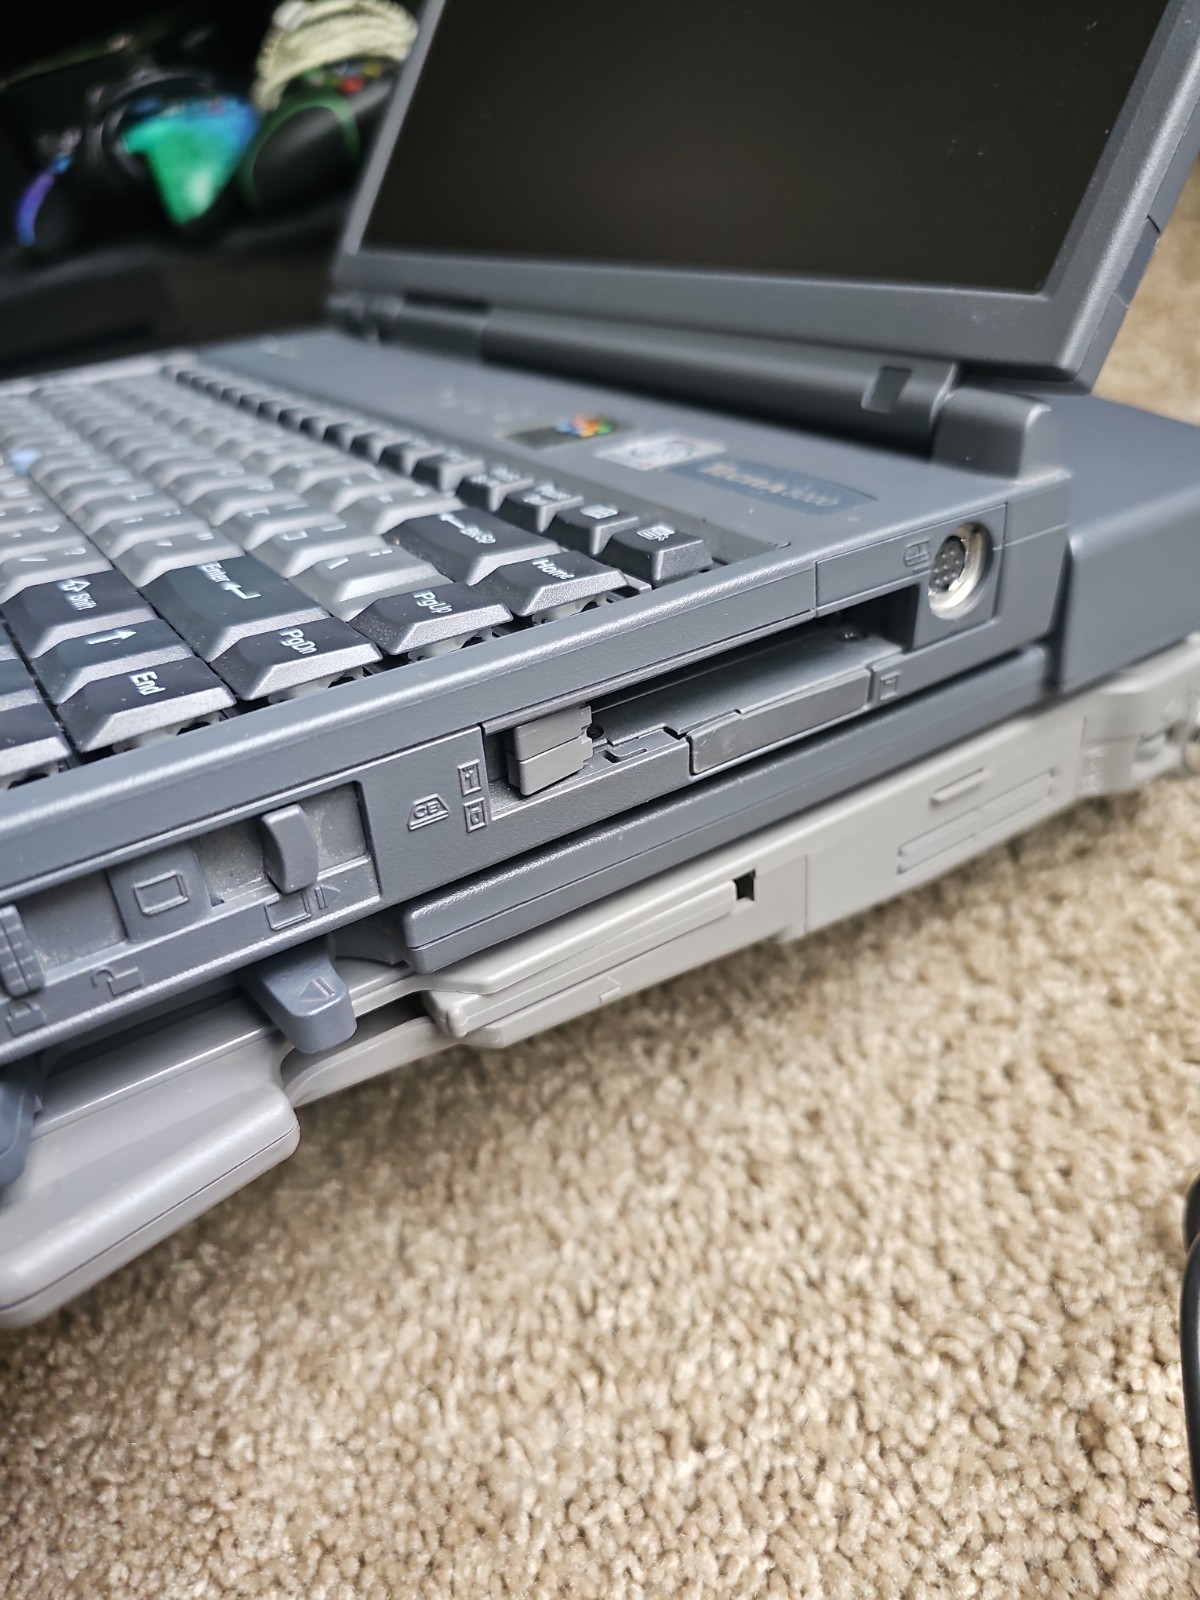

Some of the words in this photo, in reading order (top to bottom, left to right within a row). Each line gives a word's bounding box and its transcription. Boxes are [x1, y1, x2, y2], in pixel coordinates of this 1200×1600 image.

[198, 560, 232, 583] Enter
[533, 558, 575, 581] Home
[414, 590, 453, 615] PgUp
[279, 627, 319, 656] PgDn
[128, 670, 167, 697] End
